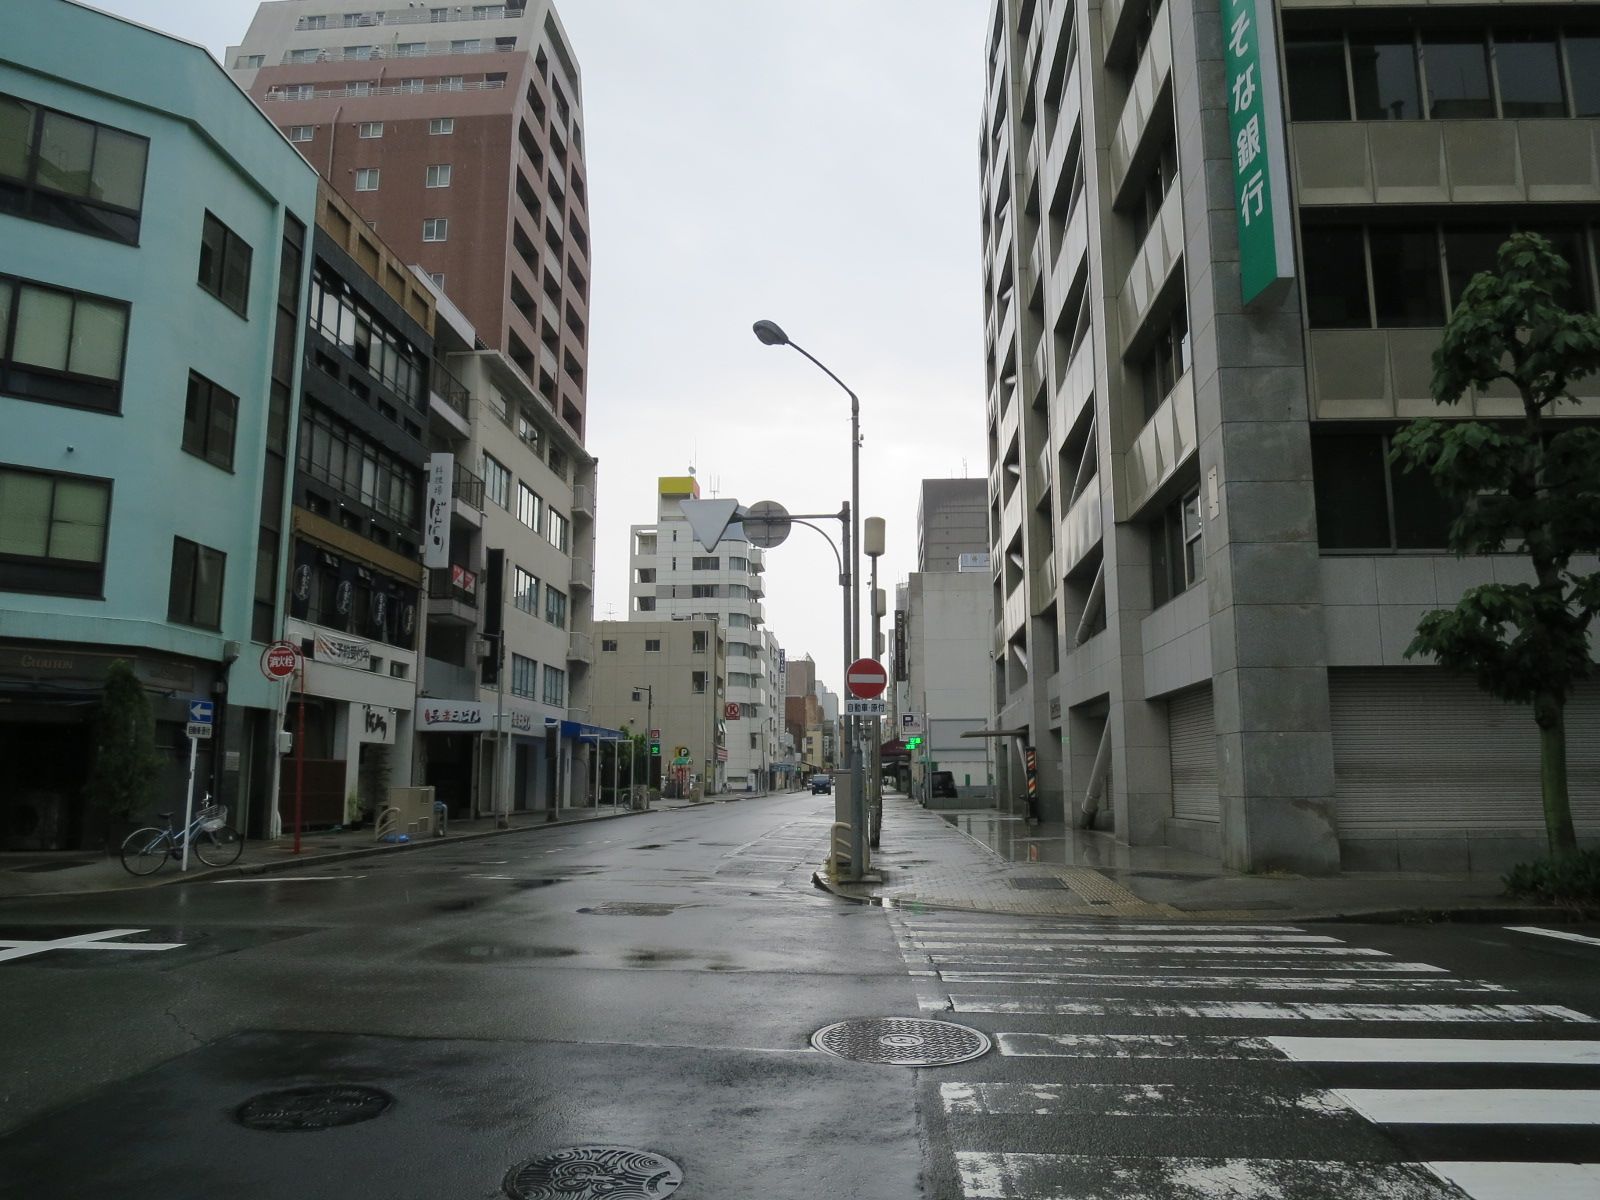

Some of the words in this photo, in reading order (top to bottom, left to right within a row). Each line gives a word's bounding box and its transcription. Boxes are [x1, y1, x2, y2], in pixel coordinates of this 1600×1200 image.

[1228, 0, 1264, 227] そな銀行
[269, 655, 294, 668] 消火栓
[847, 703, 885, 713] 自動車・原付
[902, 715, 914, 726] P
